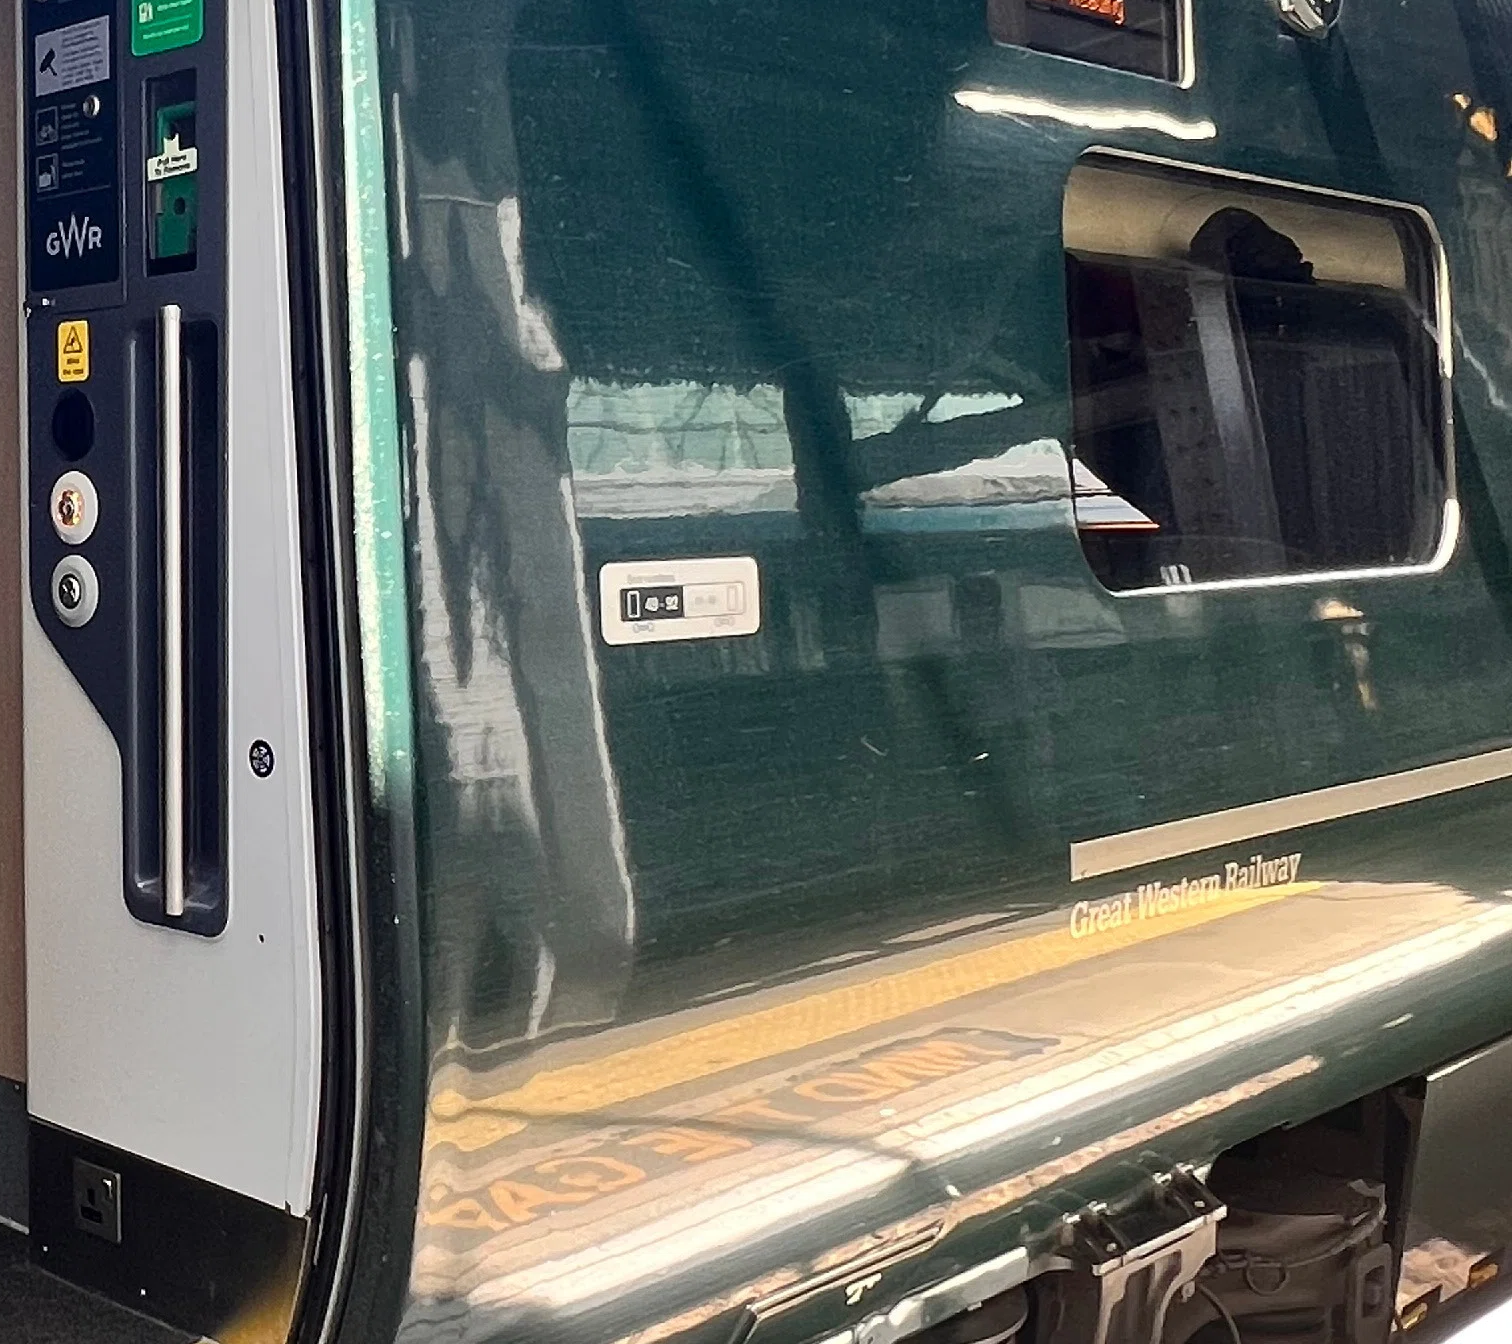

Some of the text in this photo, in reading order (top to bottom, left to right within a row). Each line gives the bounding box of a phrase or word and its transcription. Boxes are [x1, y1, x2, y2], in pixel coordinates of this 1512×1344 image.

[46, 211, 103, 260] GWR
[1070, 851, 1303, 939] Great Western Railway
